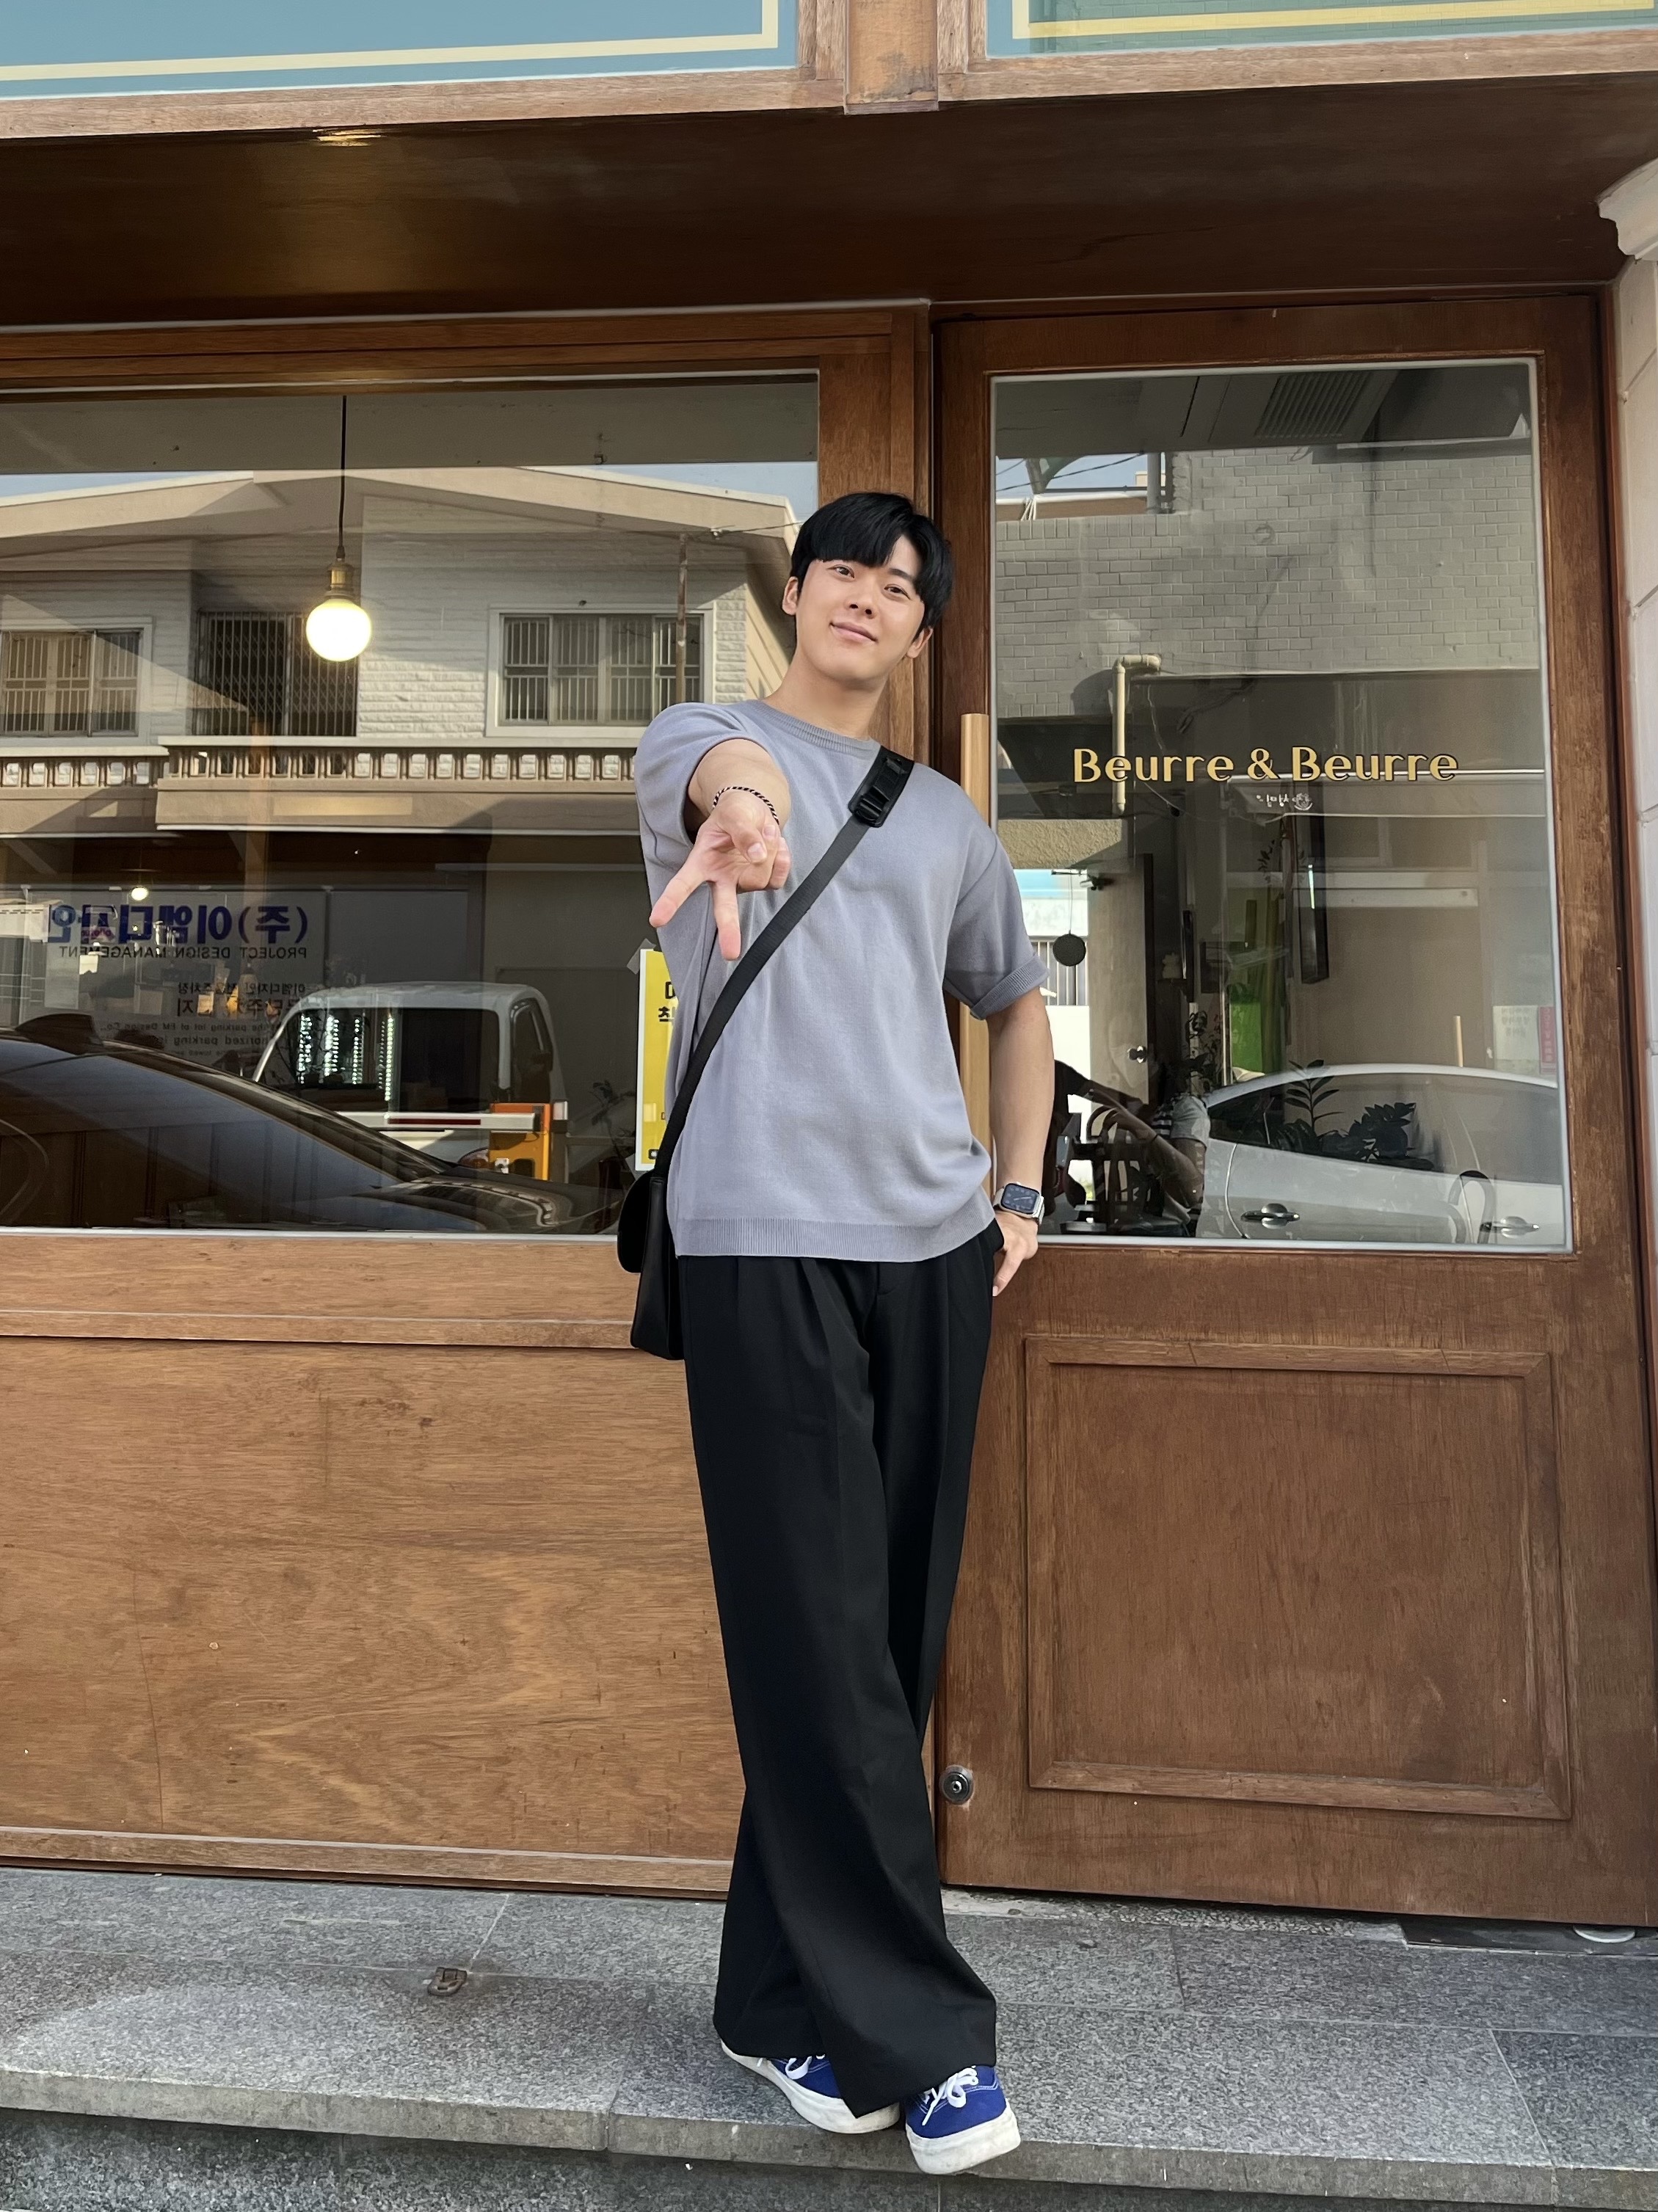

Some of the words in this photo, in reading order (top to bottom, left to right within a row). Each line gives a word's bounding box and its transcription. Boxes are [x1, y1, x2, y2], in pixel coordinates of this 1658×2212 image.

[1073, 748, 1235, 783] Beurre
[1247, 747, 1281, 782] &
[1291, 746, 1459, 782] Beurre
